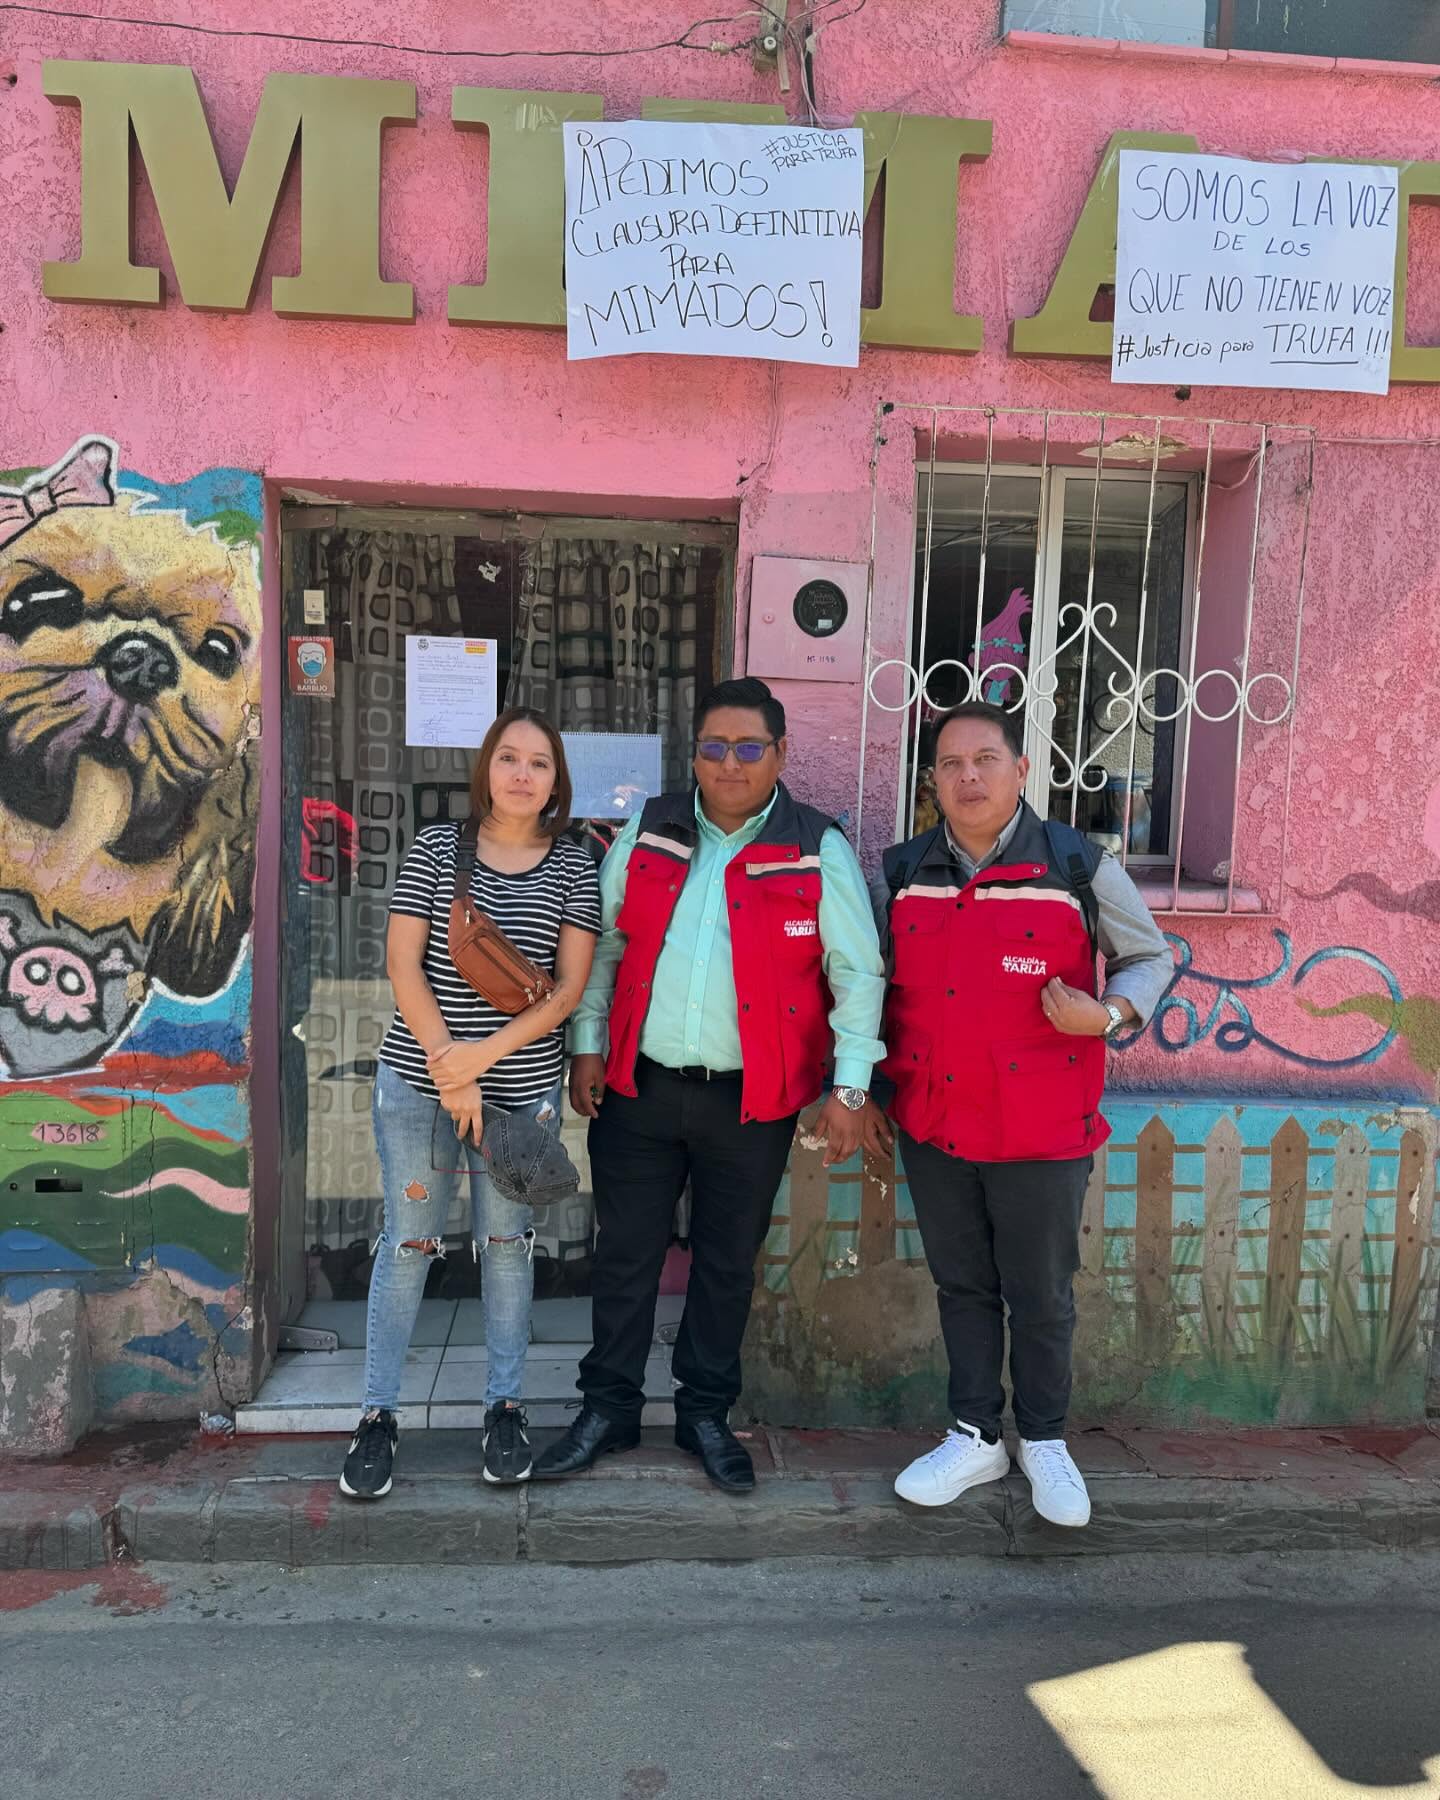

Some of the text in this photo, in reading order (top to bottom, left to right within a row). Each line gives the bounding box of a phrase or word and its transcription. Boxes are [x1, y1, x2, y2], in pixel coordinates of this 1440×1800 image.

[760, 132, 848, 158] #JUSTICIA
[772, 147, 858, 173] PARA TRUFA
[1132, 164, 1396, 229] SOMOS LA VOZ
[571, 203, 862, 258] CLAUSURA DEFINITIVA
[1212, 230, 1312, 257] DE LOS
[660, 243, 735, 280] PARA
[1128, 267, 1392, 316] QUE NO TIENEN VOZ
[584, 280, 834, 348] MIMADOS!
[1116, 333, 1212, 367] #Justicia
[1219, 340, 1255, 364] para
[1263, 322, 1355, 355] TRUFA
[1002, 955, 1040, 966] ALCALDÍA
[1002, 962, 1047, 976] TARIJA
[35, 1122, 100, 1144] 13618
